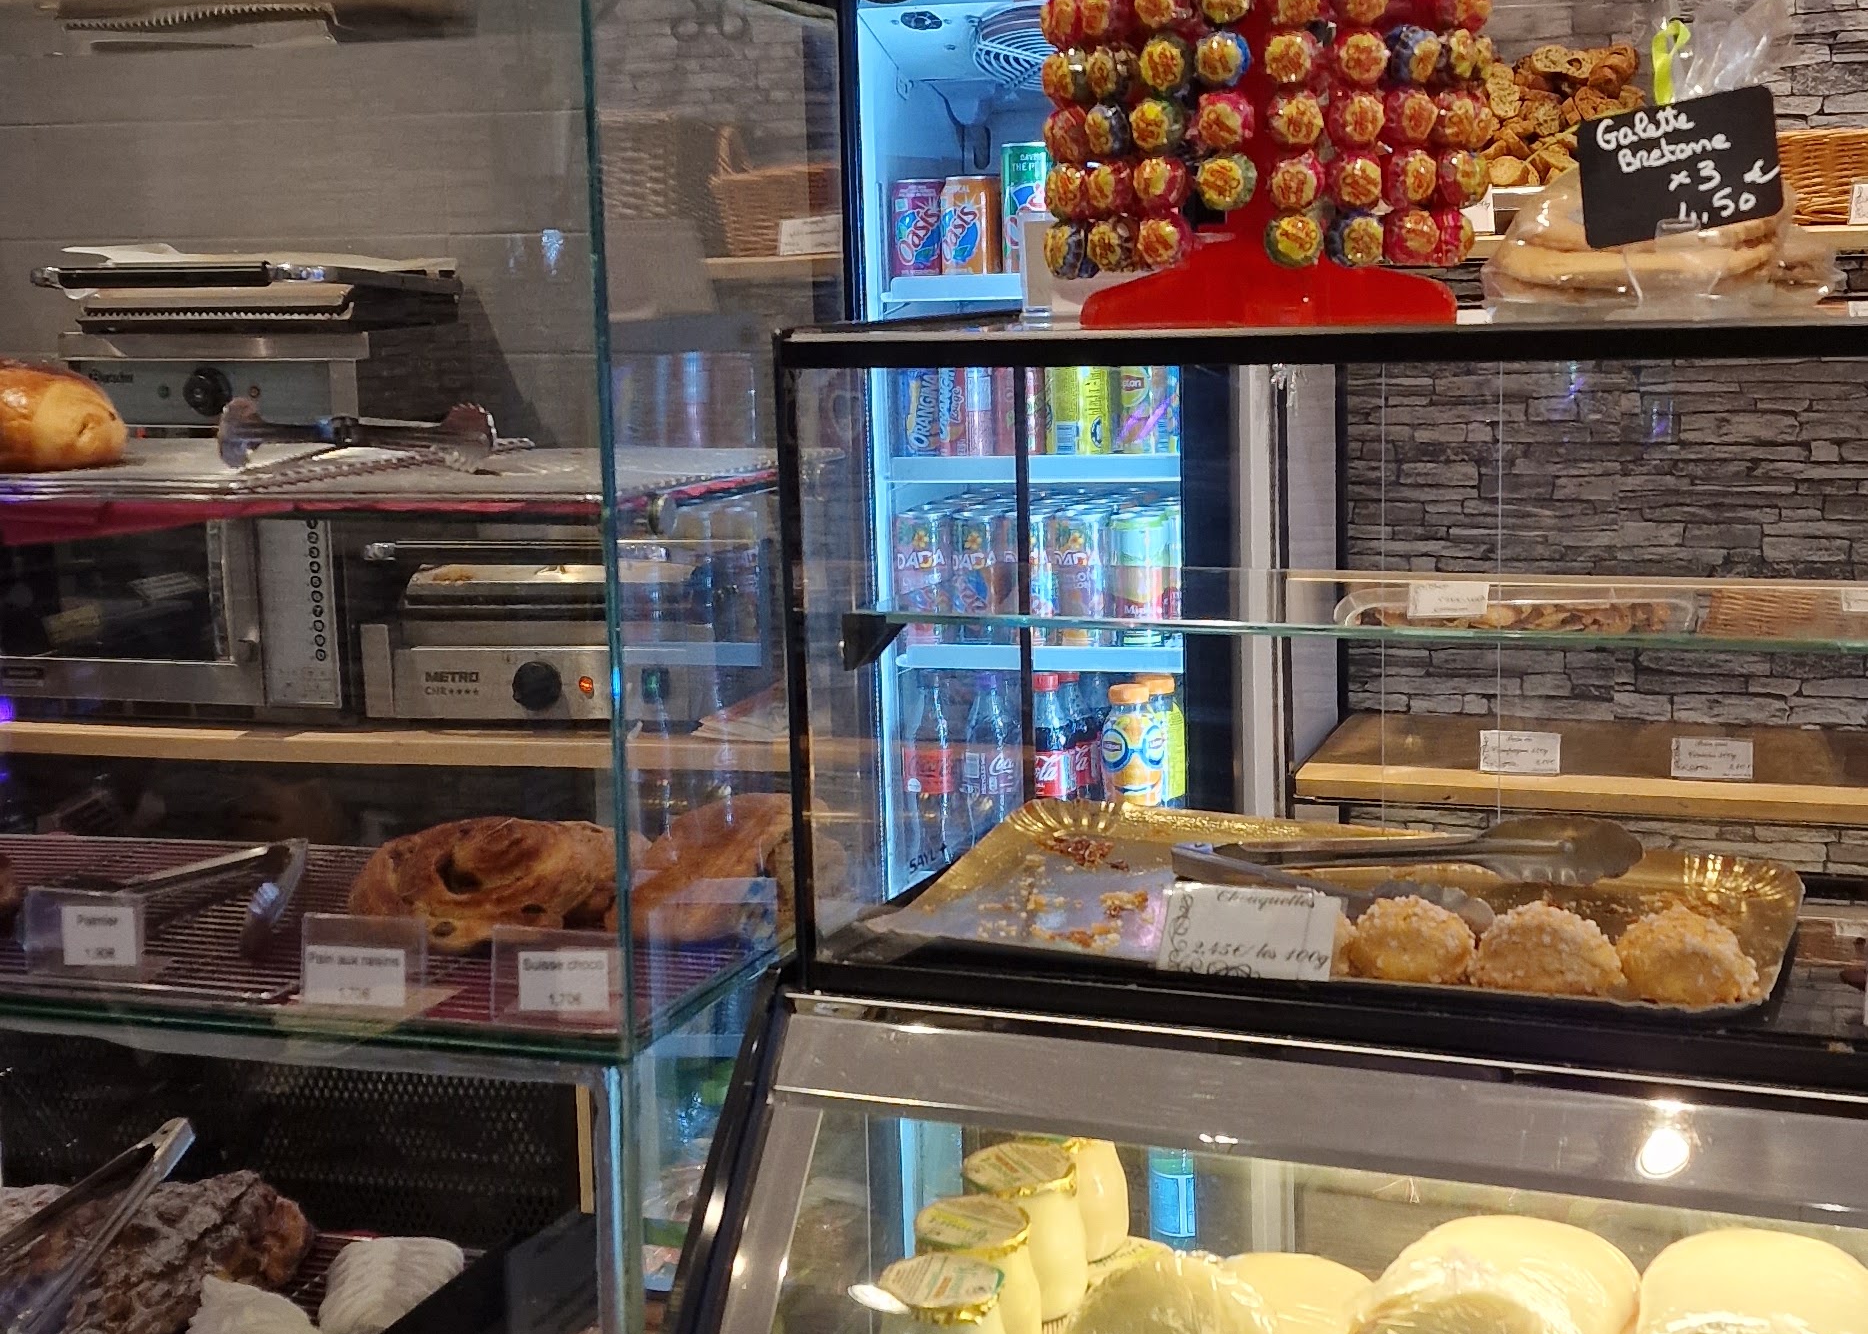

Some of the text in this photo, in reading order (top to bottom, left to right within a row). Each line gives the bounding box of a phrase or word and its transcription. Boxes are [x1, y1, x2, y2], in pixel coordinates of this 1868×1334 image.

[1596, 106, 1695, 151] Galette
[899, 208, 941, 266] Oasis
[942, 205, 978, 264] Oasis
[908, 374, 939, 449] ORANGINA
[425, 671, 479, 683] METRO
